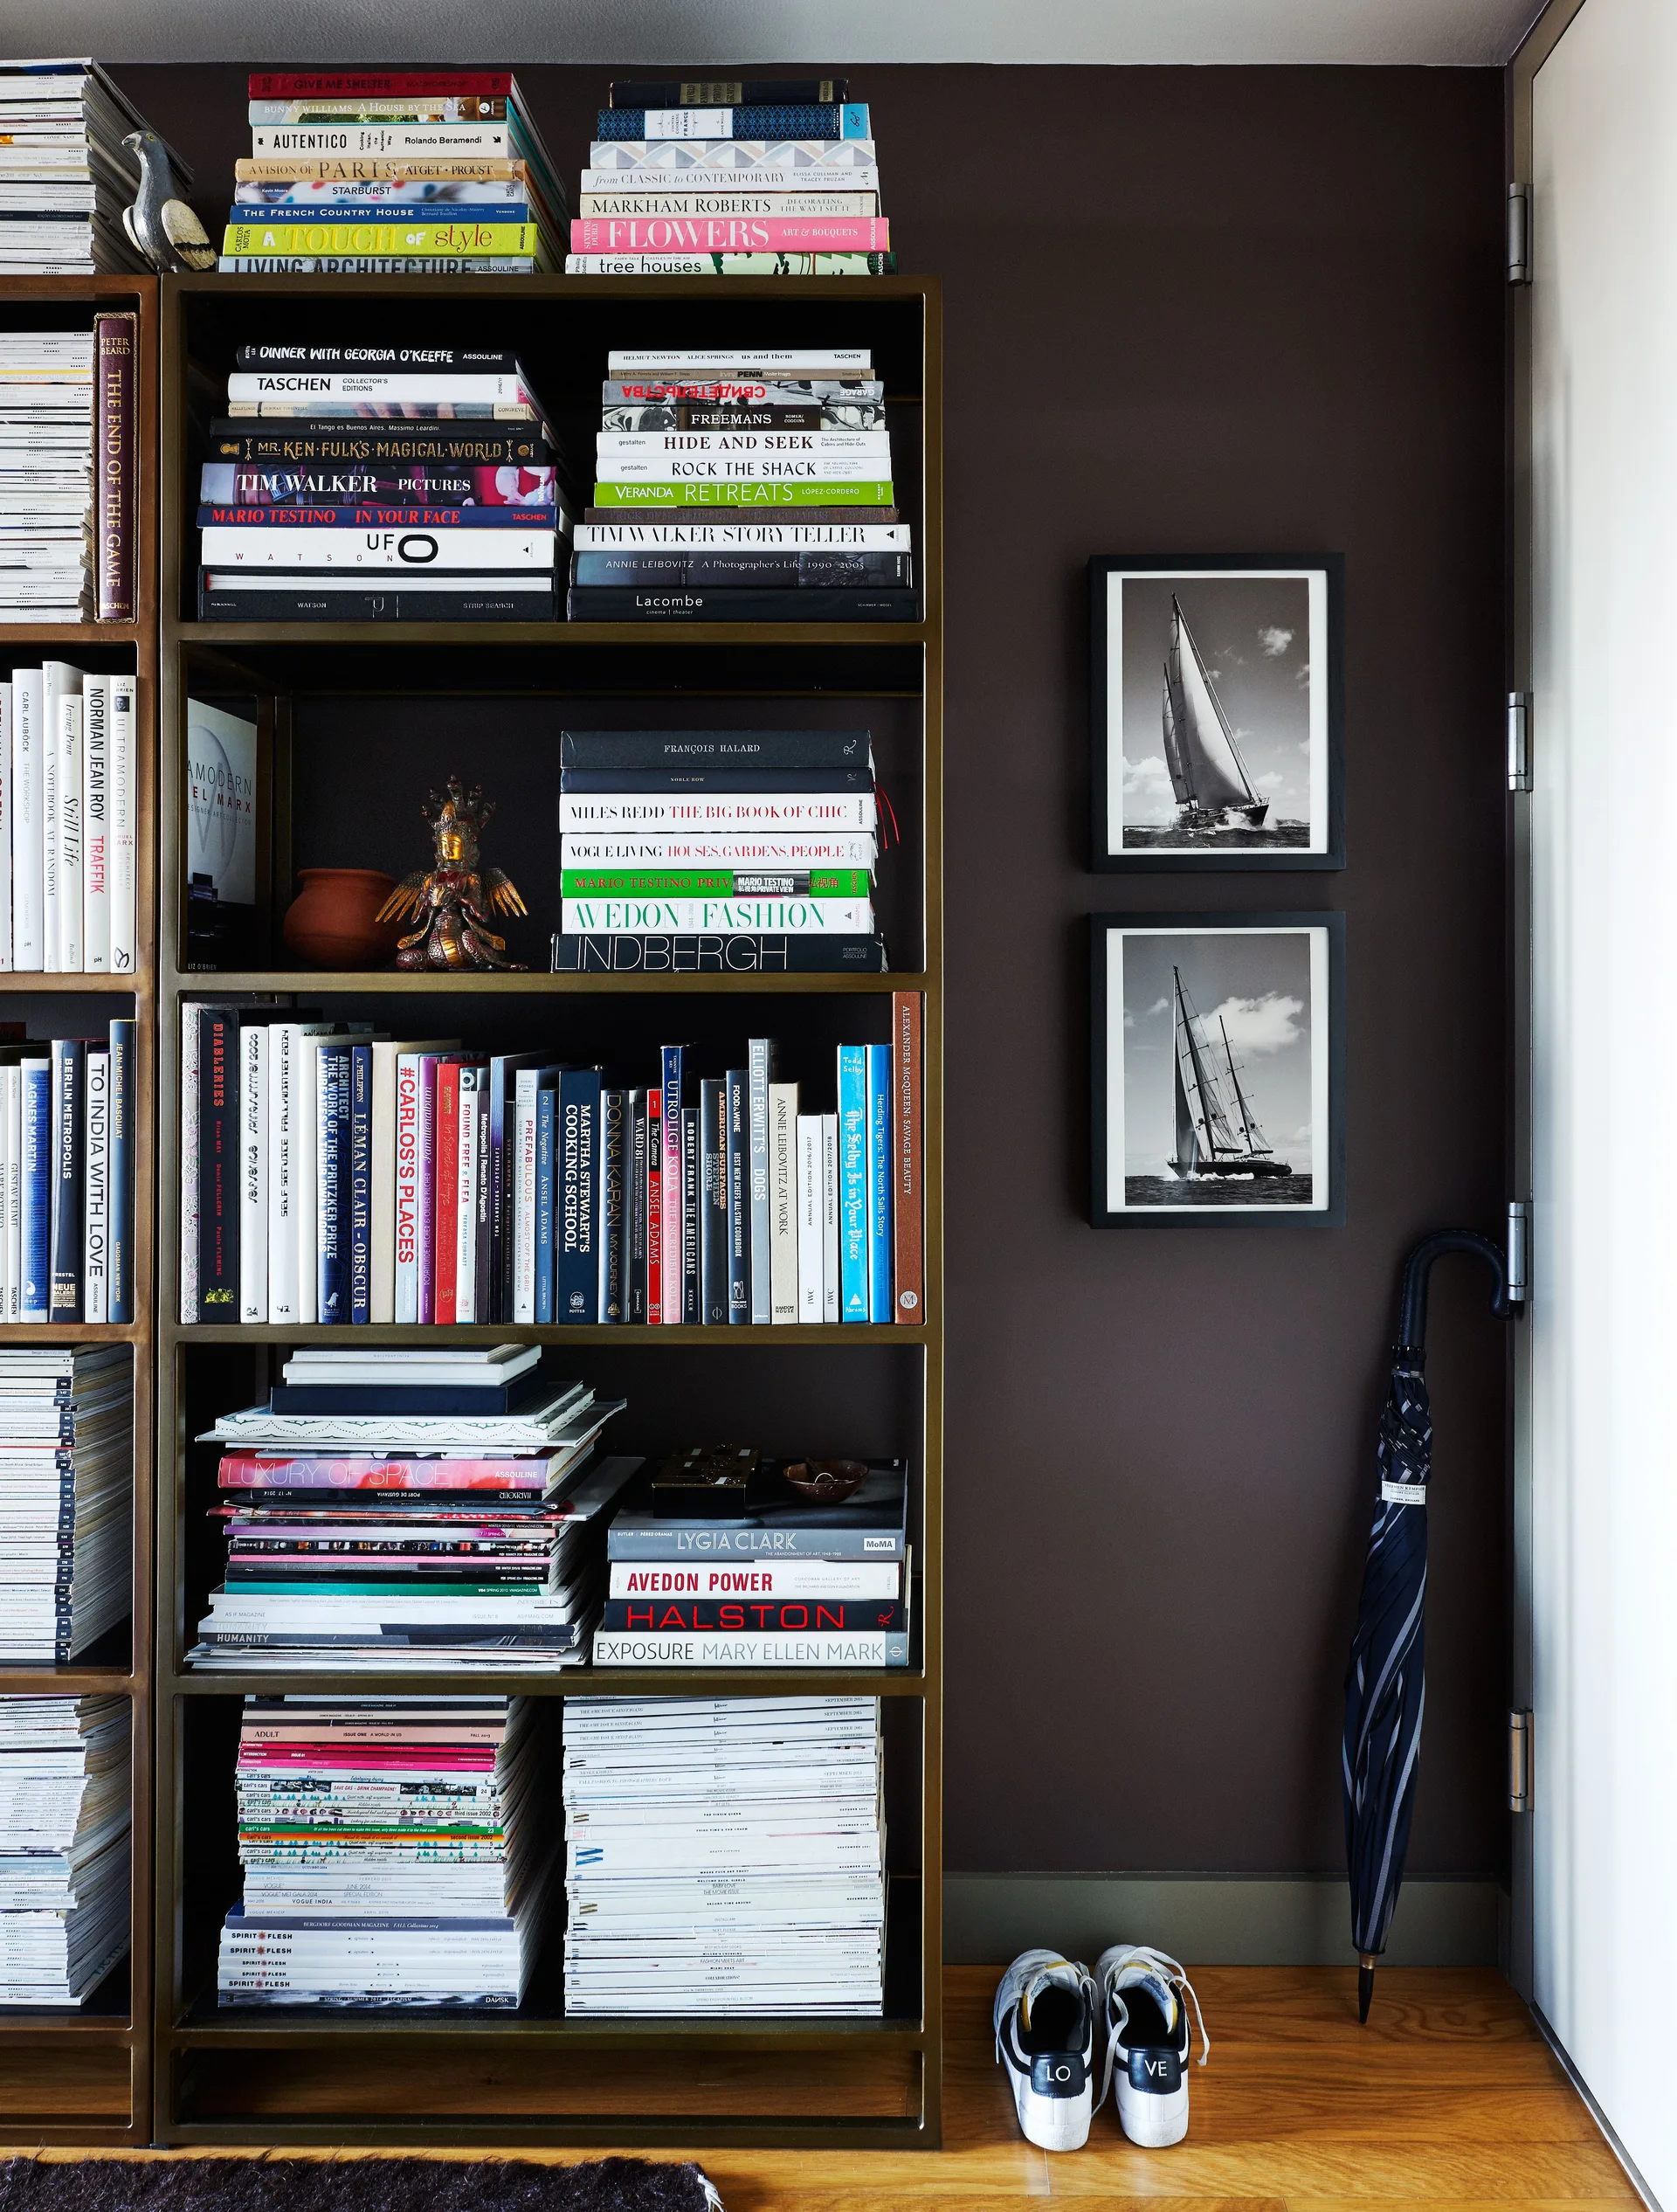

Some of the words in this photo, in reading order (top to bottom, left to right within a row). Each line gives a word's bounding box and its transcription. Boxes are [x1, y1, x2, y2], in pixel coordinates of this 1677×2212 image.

[273, 135, 347, 149] AUTENTICO
[593, 175, 618, 187] from
[621, 175, 670, 183] CLASSIC
[674, 174, 684, 183] to
[687, 174, 784, 183] CONTEMPORARY
[592, 199, 688, 213] MARKHAM
[695, 198, 771, 212] ROBERTS
[263, 232, 275, 246] A
[283, 226, 397, 251] TOUCH
[435, 225, 492, 252] style
[607, 219, 769, 247] FLOWERS
[599, 259, 634, 273] tree
[641, 256, 701, 273] houses
[260, 347, 306, 360] DINNER
[310, 348, 340, 360] WITH
[344, 349, 395, 361] GEORGIA
[107, 371, 121, 407] THE
[257, 378, 331, 391] TASCHEN
[691, 415, 771, 425] FREEMANS
[107, 419, 121, 453] END
[664, 437, 710, 450] HIDE
[718, 437, 757, 450] AND
[765, 437, 813, 449] SEEK
[107, 460, 121, 485] OF
[672, 462, 716, 475] ROCK
[725, 462, 756, 475] THE
[762, 462, 817, 475] SHACK
[238, 474, 280, 492] TIM
[286, 474, 377, 493] WALKER
[398, 479, 470, 491] PICTURES
[615, 486, 673, 498] VERANDA
[685, 483, 793, 501] RETREATS
[107, 493, 121, 529] THE
[211, 510, 264, 522] MARIO
[268, 510, 335, 522] TESTINO
[355, 510, 373, 522] IN
[377, 511, 419, 523] YOUR
[424, 511, 459, 523] FACE
[587, 527, 624, 543] TIM
[631, 527, 715, 543] WALKER
[723, 527, 783, 543] STORY
[790, 527, 866, 543] TELLER
[107, 534, 121, 587] GAME
[637, 595, 703, 607] Lacombe
[90, 688, 104, 750] NORMAN
[664, 744, 714, 754] FRANÇOIS
[90, 754, 104, 789] JEAN
[115, 718, 125, 828] ULTRAMODERN
[64, 795, 79, 829] Still
[90, 795, 104, 821] ROY
[570, 806, 618, 819] MILES
[622, 806, 664, 818] REDD
[669, 806, 701, 818] THE
[706, 806, 732, 818] BIG
[736, 806, 780, 819] BOOK
[784, 806, 804, 818] OF
[808, 805, 846, 818] CHIC
[64, 834, 79, 867] Life
[570, 846, 612, 857] VOGUE
[618, 846, 661, 857] LIVING
[90, 836, 104, 894] TRAFFIK
[575, 878, 624, 888] MARIO
[630, 878, 691, 888] TESTINO
[571, 903, 680, 928] AVEDON
[703, 903, 826, 928] FASHION
[556, 936, 787, 970] LINDBERGH
[91, 1064, 104, 1092] TO
[213, 1023, 224, 1107] DIABLERIES
[752, 1046, 765, 1093] ELLIOTT
[339, 1056, 349, 1120] ARCHITECT
[27, 1082, 37, 1123] AGNES
[876, 1094, 885, 1125] Herding
[91, 1099, 104, 1156] INDIA
[580, 1104, 590, 1168] MARTHA
[876, 1127, 885, 1152] Tigers:
[27, 1127, 36, 1172] MARTIN
[63, 1105, 72, 1179] METROPOLIS
[354, 1113, 369, 1171] LÉMAN
[565, 1104, 577, 1181] COOKING
[90, 1161, 104, 1216] WITH
[754, 1169, 765, 1200] DOGS
[354, 1178, 365, 1227] CLAIR
[399, 1185, 413, 1263] PLACES
[564, 1185, 576, 1252] SCHOOL
[875, 1216, 885, 1236] Story
[89, 1224, 104, 1277] LOVE
[354, 1242, 365, 1309] OBSCUR
[227, 1463, 322, 1484] LUXURY
[337, 1463, 361, 1484] OF
[369, 1464, 449, 1484] SPACE
[677, 1532, 731, 1550] LYGIA
[735, 1532, 797, 1550] CLARK
[627, 1573, 699, 1592] AVEDON
[709, 1573, 772, 1591] POWER
[627, 1605, 845, 1628] HALSTON
[217, 1634, 269, 1642] HUMANITY
[597, 1642, 694, 1660] EXPOSURE
[702, 1642, 758, 1660] MARY
[763, 1642, 820, 1660] ELLEN
[827, 1642, 883, 1660] MARK
[1047, 2065, 1071, 2081] LO
[1145, 2060, 1167, 2077] VE
